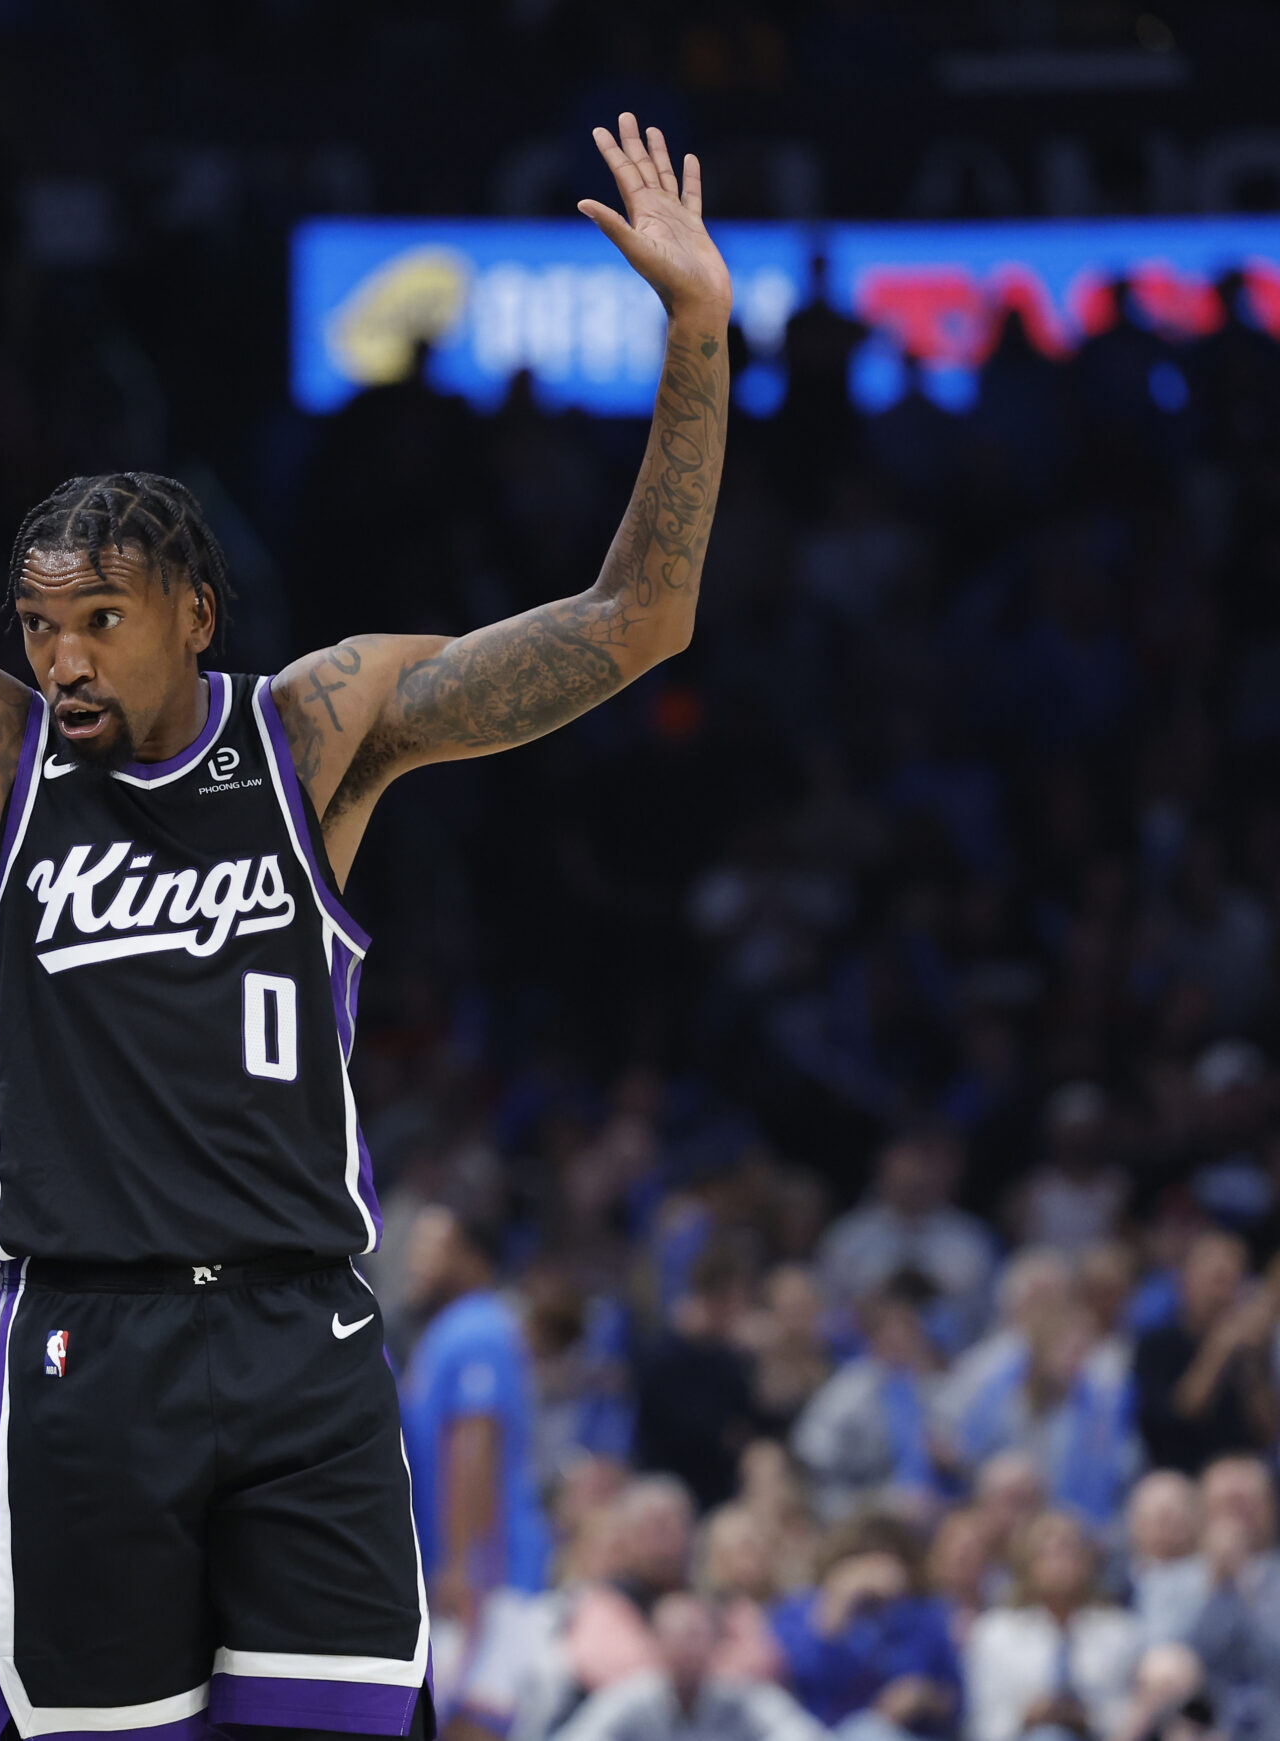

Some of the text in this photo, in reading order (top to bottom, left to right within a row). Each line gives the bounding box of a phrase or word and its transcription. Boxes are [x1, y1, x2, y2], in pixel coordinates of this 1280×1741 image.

[198, 778, 263, 795] PHOONG LAW
[26, 841, 296, 975] Kings
[243, 970, 298, 1082] 0
[46, 1366, 57, 1375] NBA
